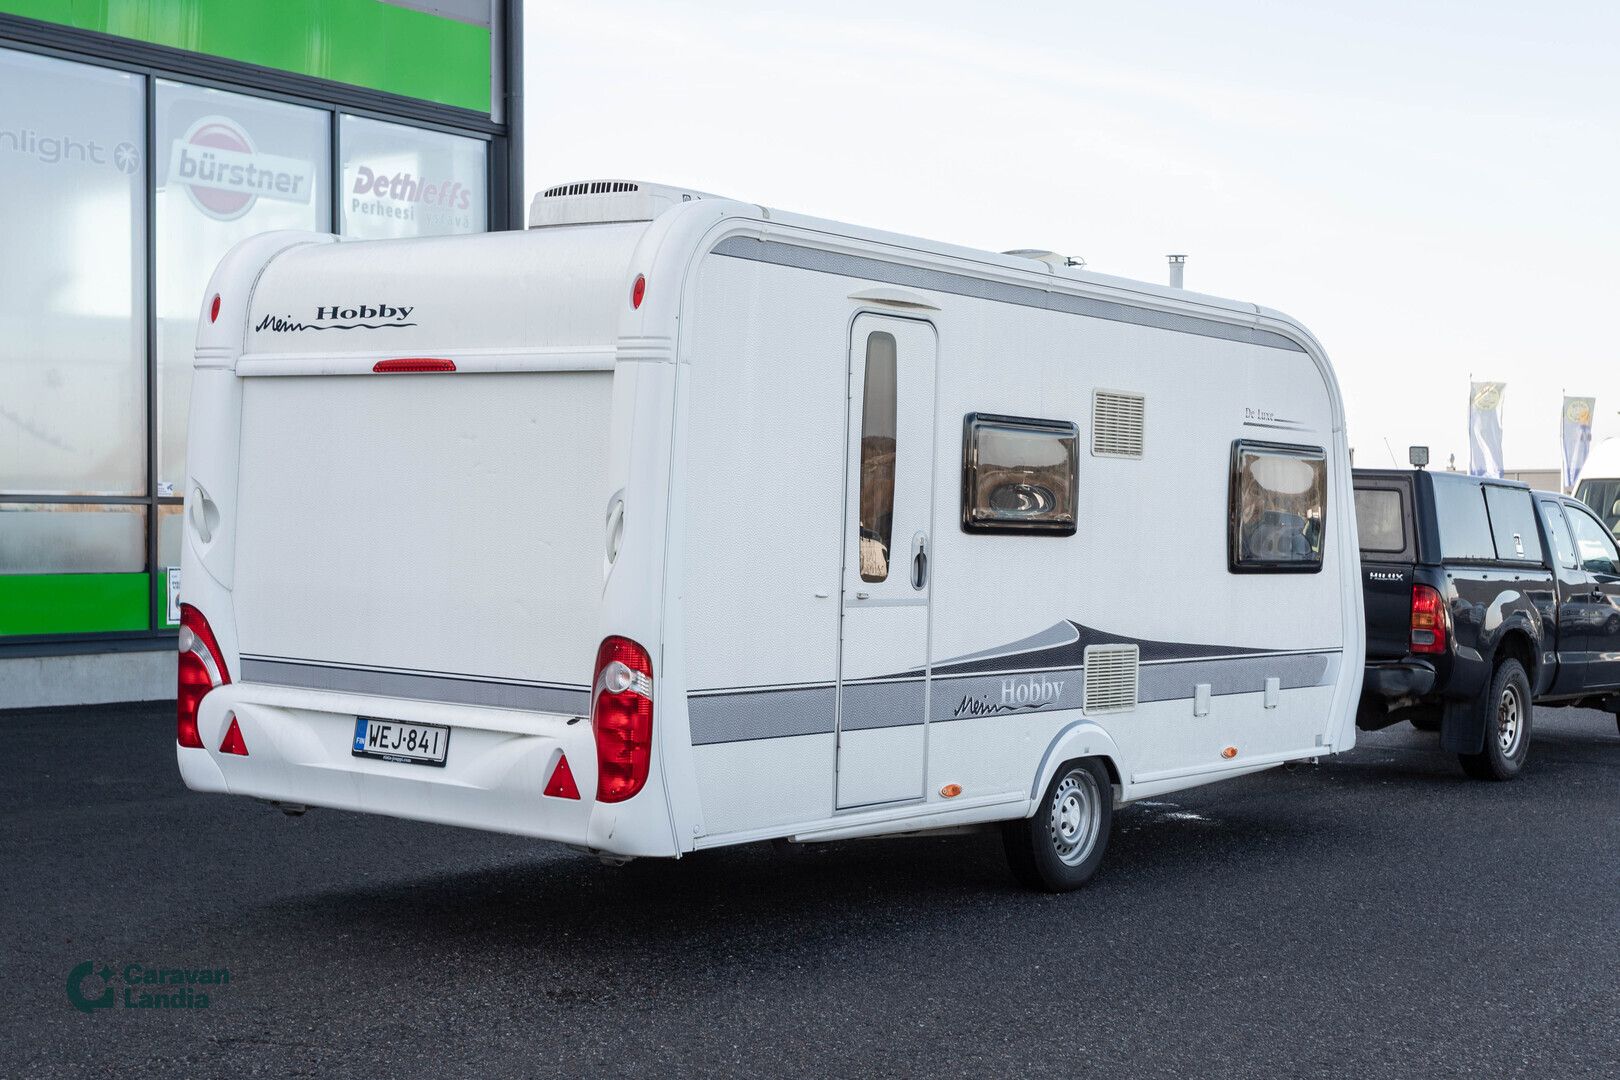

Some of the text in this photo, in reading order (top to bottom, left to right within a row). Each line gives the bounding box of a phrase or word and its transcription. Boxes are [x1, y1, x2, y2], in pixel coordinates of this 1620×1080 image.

[179, 149, 304, 194] bürstner
[352, 165, 471, 210] Dethleffs
[351, 198, 415, 221] Perheesi
[255, 304, 415, 333] Mein Hobby
[1369, 571, 1404, 582] HILUX
[954, 675, 1065, 715] Mein Hobby
[368, 723, 439, 755] WEJ-841
